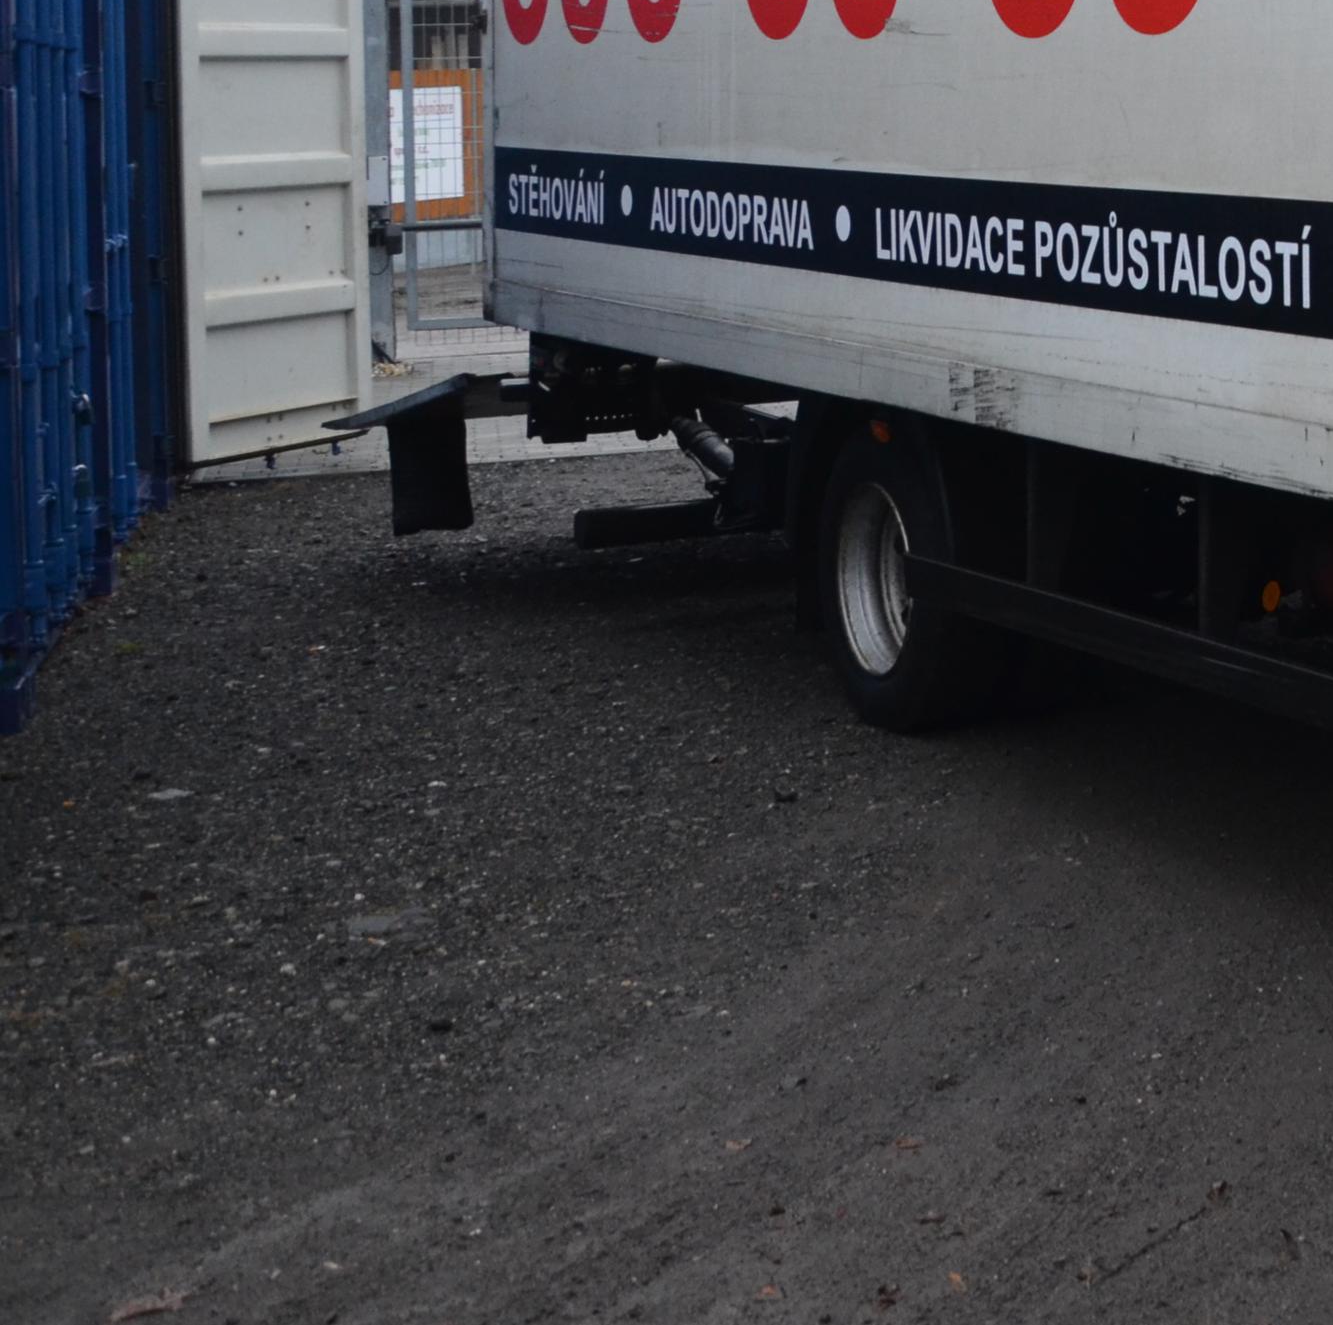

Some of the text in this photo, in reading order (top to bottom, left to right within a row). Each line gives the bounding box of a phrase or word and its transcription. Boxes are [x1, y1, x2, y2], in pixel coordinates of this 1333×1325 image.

[508, 163, 605, 225] STĚHOVÁNÍ
[650, 186, 814, 250] AUTODOPRAVA
[875, 207, 1025, 276] LIKVIDACE
[1034, 210, 1312, 310] POZŮSTALOSTÍ
